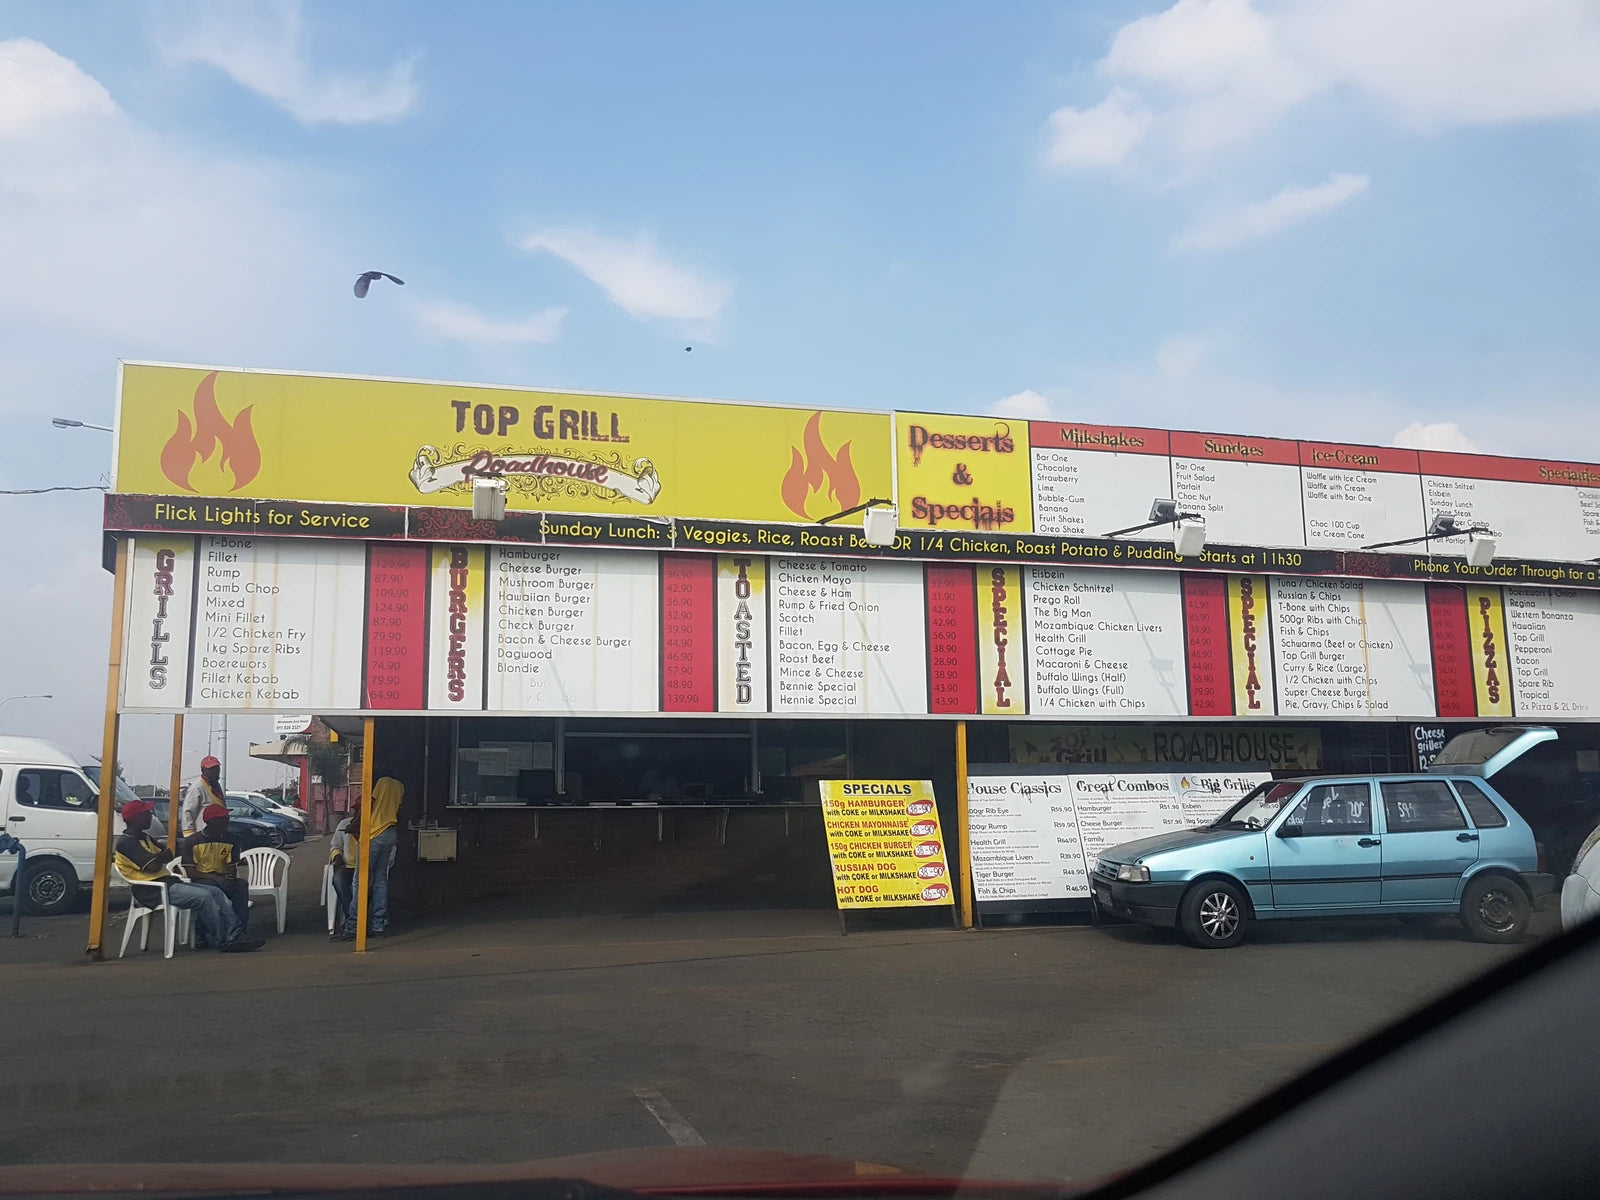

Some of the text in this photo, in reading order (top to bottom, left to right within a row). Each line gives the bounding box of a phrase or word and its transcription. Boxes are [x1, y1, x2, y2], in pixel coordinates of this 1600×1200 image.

[451, 400, 630, 443] TOP GRILL
[909, 422, 1014, 455] Desserts
[1060, 428, 1144, 448] Milkshakes
[1204, 439, 1264, 457] Sundaes
[1312, 448, 1379, 465] Ice-Cream
[461, 450, 609, 485] Roadhouse
[1036, 464, 1078, 472] Chocolate
[952, 462, 973, 486] &
[1037, 474, 1078, 484] Strawberry
[1038, 494, 1085, 503] Bubble-Gum
[912, 497, 1014, 528] Specials
[1039, 504, 1068, 512] Banana
[154, 504, 370, 529] Flick Lights for Service
[209, 537, 252, 550] T-Bone
[539, 520, 602, 538] Sunday
[608, 524, 660, 540] Lunch:
[683, 525, 752, 544] Veggies,
[758, 529, 795, 546] Rice,
[800, 532, 844, 547] Roast
[889, 536, 912, 550] OR
[920, 536, 944, 551] 1/4
[950, 538, 1012, 555] Chicken,
[1016, 541, 1056, 554] Roast
[1061, 543, 1108, 557] Potato
[1113, 545, 1122, 558] &
[1127, 546, 1183, 562] Pudding
[1200, 549, 1236, 564] Starts
[1241, 552, 1256, 564] at
[1263, 553, 1302, 566] 11h30
[208, 552, 238, 563] Fillet
[207, 567, 240, 580] Rump
[499, 562, 582, 576] Cheese Burger
[1414, 559, 1595, 580] Phone Your Order Through for a
[499, 577, 594, 590] Mushroom Burger
[778, 573, 852, 586] Chicken Mayo
[206, 582, 280, 596] Lamb Chop
[375, 588, 409, 598] 109.90
[667, 584, 692, 593] 42.90
[1032, 582, 1114, 594] Chicken Schnitzel
[206, 597, 246, 608] Mixed
[498, 592, 590, 604] Hawaiian Burger
[1033, 595, 1080, 606] Prego Roll
[1510, 599, 1536, 609] Regina
[778, 601, 880, 612] Rump & Fried Onion
[150, 548, 176, 690] GRILLS
[447, 547, 468, 702] BURGERS
[778, 614, 815, 624] Scotch
[734, 558, 752, 705] TOASTED
[1034, 620, 1162, 633] Mozambique Chicken Livers
[206, 627, 306, 642] 1/2 Chicken Fry
[206, 642, 300, 656] 1kg Spare Ribs
[778, 640, 890, 653] Bacon, Egg & Cheese
[1281, 638, 1322, 648] Schwarma
[1514, 644, 1552, 654] Pepperoni
[498, 648, 552, 660] Dagwood
[1478, 596, 1500, 704] PIZZAS
[202, 658, 267, 670] Boerewors
[372, 660, 400, 670] 74.90
[497, 662, 540, 674] Blondie
[1282, 663, 1367, 674] Curry & Rice (Large)
[1036, 672, 1126, 684] Buffalo Wings (Half)
[668, 694, 698, 704] 139.90
[1519, 690, 1550, 700] Tropical
[1414, 726, 1446, 740] Cheese
[1154, 731, 1296, 764] ROADHOUSE
[1418, 740, 1444, 754] griller
[843, 784, 912, 795] SPECIALS
[1010, 781, 1062, 796] Classics
[1076, 778, 1170, 792] Great Combos
[1200, 778, 1221, 794] Big
[825, 799, 906, 808] 150g HAMBURGER
[1077, 805, 1112, 813] Hamburger
[842, 808, 860, 816] COKE
[868, 808, 906, 816] MILKSHAKE
[862, 820, 909, 828] MAYONNAISE
[1102, 820, 1122, 828] Burger
[830, 830, 844, 838] with
[844, 830, 863, 838] COKE
[830, 841, 913, 852] 150g CHICKEN BURGER
[994, 838, 1006, 846] Grill
[834, 862, 896, 872] RUSSIAN DOG
[992, 870, 1014, 878] Burger
[837, 885, 878, 894] HOT DOG
